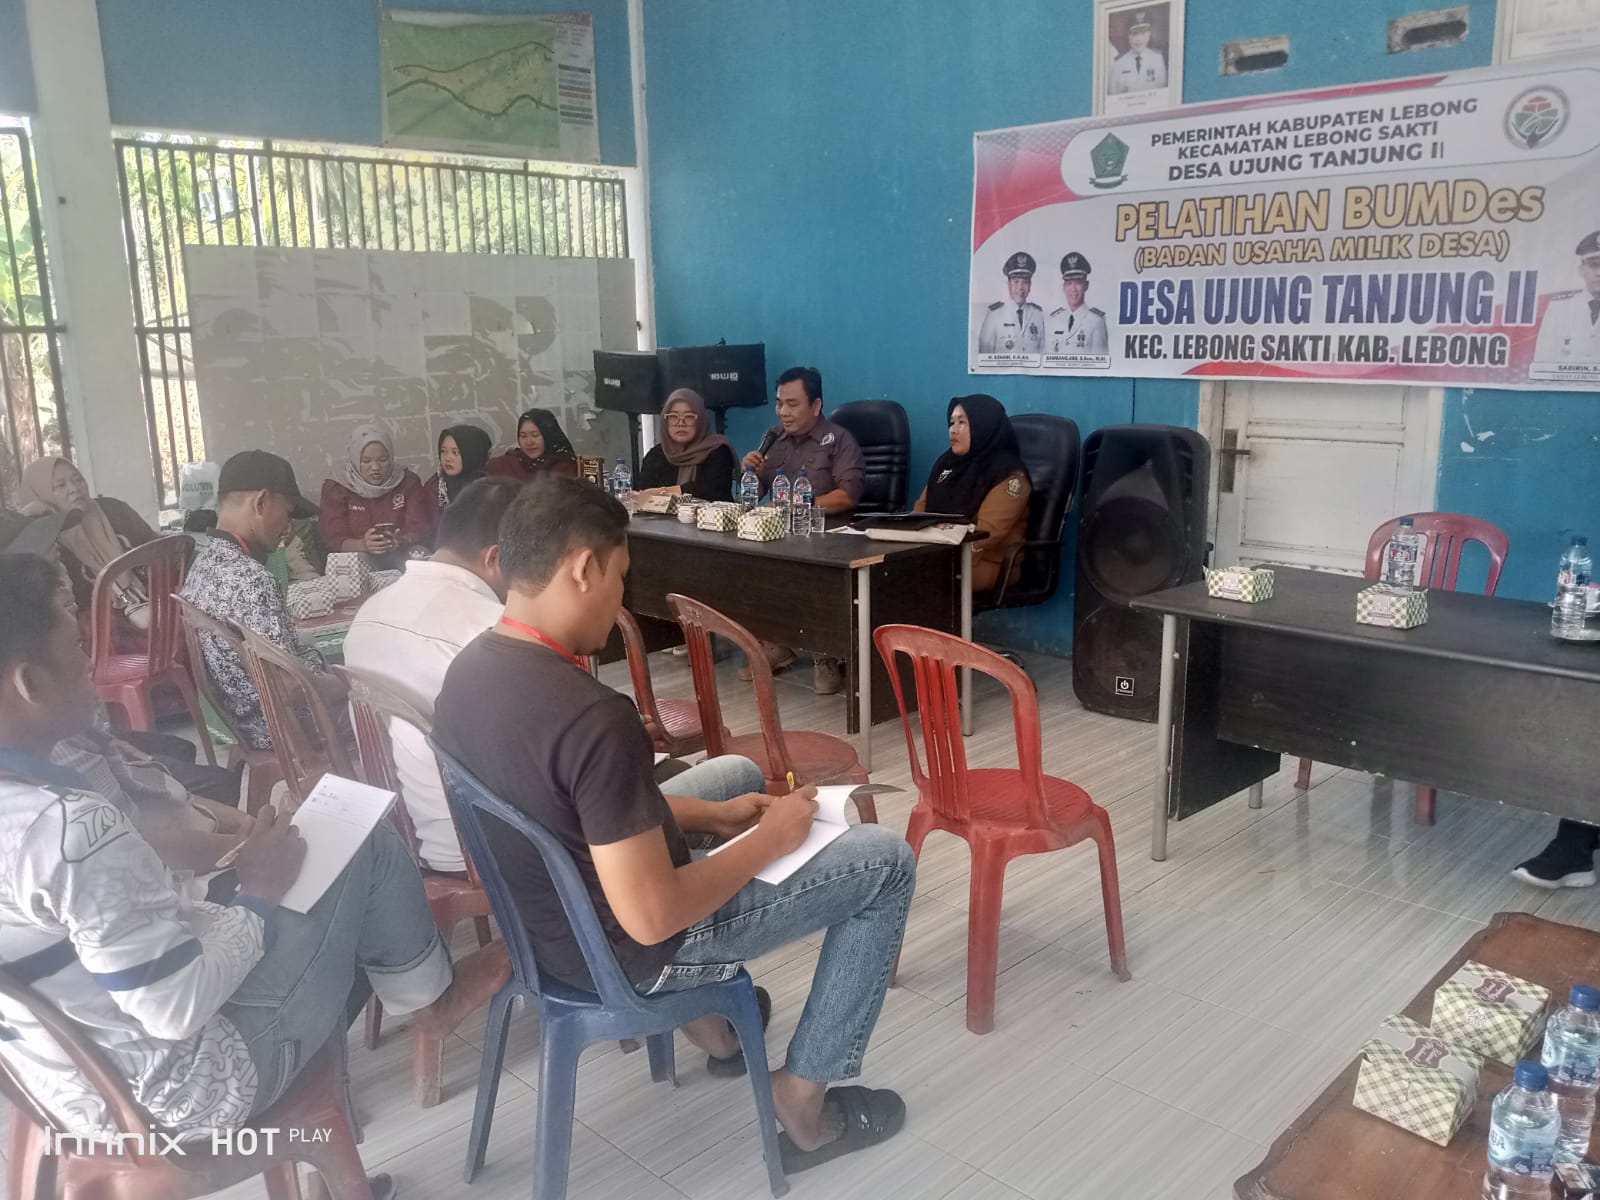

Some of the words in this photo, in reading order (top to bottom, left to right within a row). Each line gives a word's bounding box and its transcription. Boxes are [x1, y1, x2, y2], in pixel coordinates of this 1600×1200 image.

[1151, 121, 1262, 147] PEMERINTAH
[1266, 107, 1385, 136] KABUPATEN
[1390, 98, 1478, 121] LEBONG
[1177, 135, 1288, 160] KECAMATAN
[1293, 127, 1372, 149] LEBONG
[1378, 121, 1439, 141] SAKTI
[1168, 161, 1223, 182] DESA
[1229, 154, 1303, 176] UJUNG
[1309, 142, 1423, 169] TANJUNG
[1431, 141, 1445, 159] II
[1115, 188, 1331, 242] PELATIHAN
[1342, 178, 1546, 230] BUMDes
[1134, 242, 1226, 274] (BADAN
[1233, 238, 1325, 265] USAHA
[1329, 233, 1414, 262] MILIK
[1418, 228, 1511, 263] DESA)
[1118, 278, 1196, 325] DESA
[1203, 275, 1313, 325] UJUNG
[1321, 270, 1495, 325] TANJUNG
[1503, 269, 1539, 324] II
[1124, 334, 1168, 360] KEC.
[1172, 334, 1256, 362] LEBONG
[1260, 334, 1332, 362] SAKTI
[1337, 334, 1395, 363] KAB.
[1401, 335, 1508, 366] LEBONG
